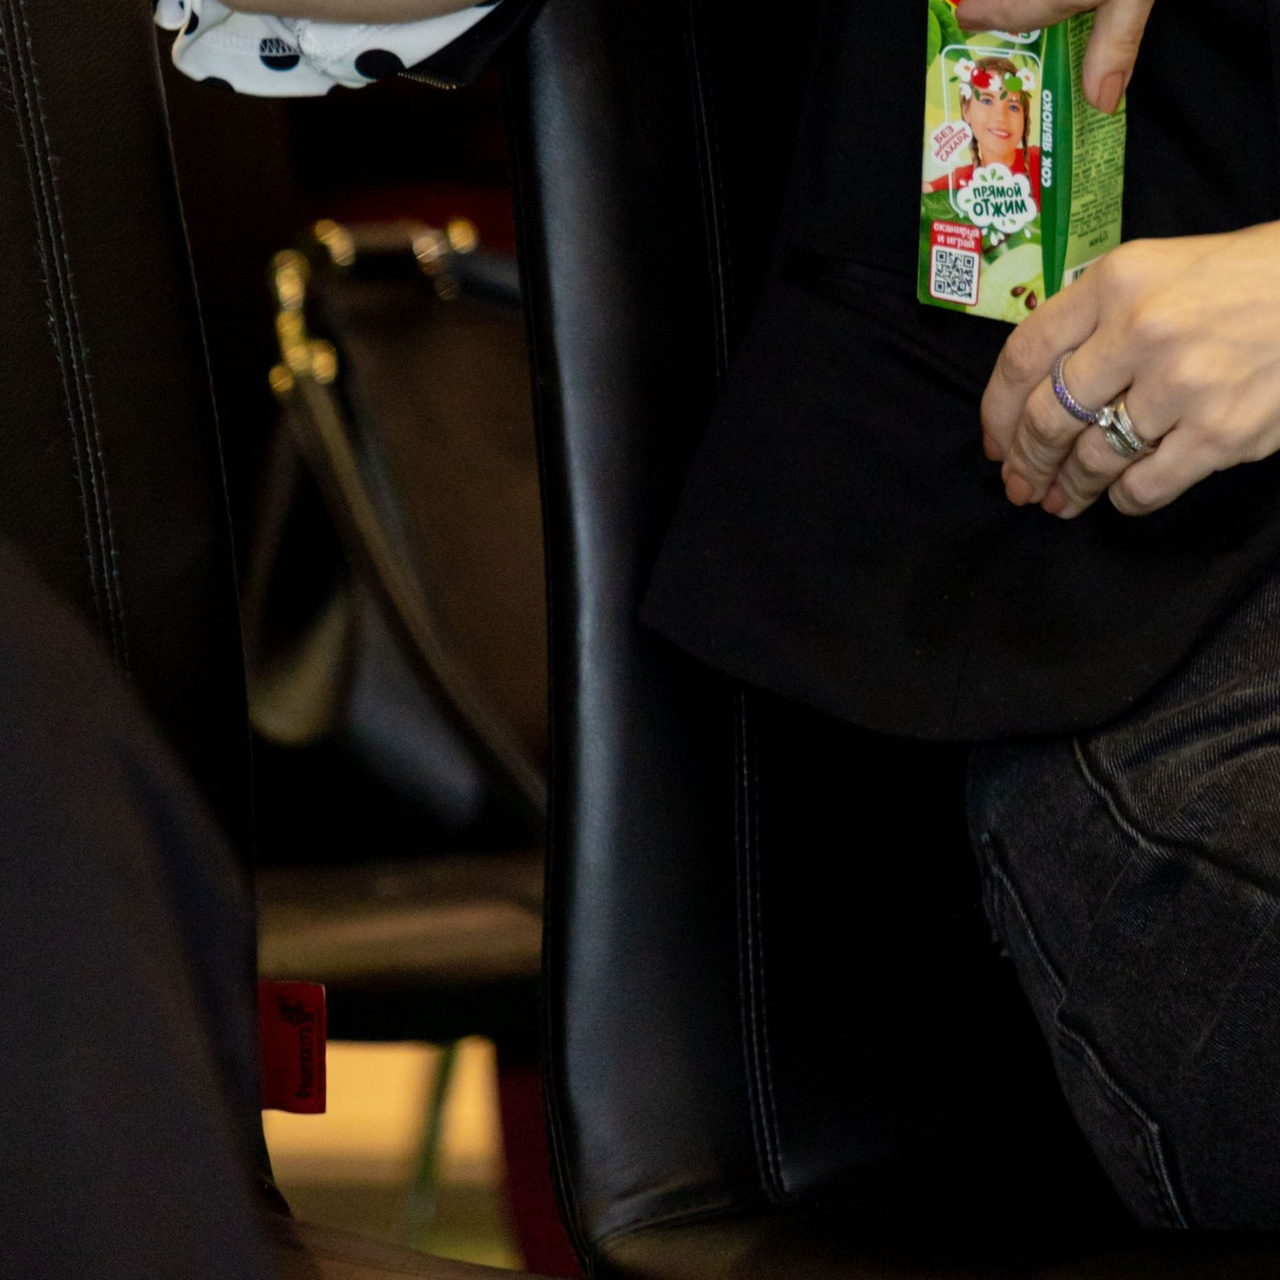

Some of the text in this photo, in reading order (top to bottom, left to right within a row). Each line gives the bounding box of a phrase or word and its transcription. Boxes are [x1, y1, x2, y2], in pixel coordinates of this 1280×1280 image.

[934, 125, 954, 144] БЕЗ
[1041, 89, 1053, 188] СОК ЯБЛОКО
[940, 132, 970, 162] САХАРА
[973, 183, 1022, 200] ПРЯМОЙ
[973, 199, 1028, 218] ОТЖИМ
